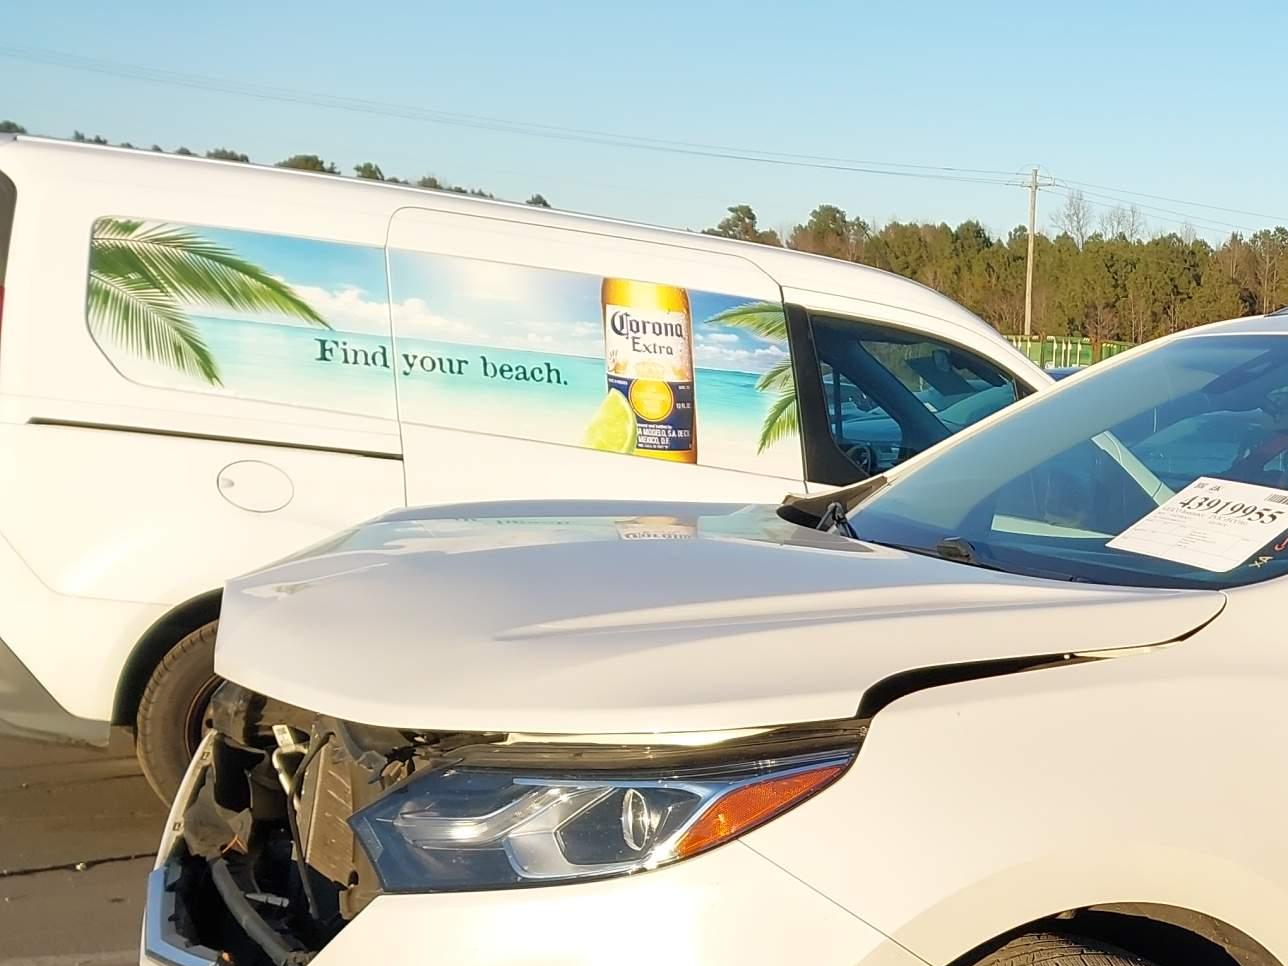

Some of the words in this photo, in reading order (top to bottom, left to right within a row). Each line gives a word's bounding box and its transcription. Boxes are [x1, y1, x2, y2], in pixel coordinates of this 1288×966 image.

[610, 311, 685, 340] Corona
[631, 336, 674, 355] Extra
[314, 338, 390, 369] Find
[402, 353, 469, 376] your
[480, 356, 569, 386] beach.
[1179, 495, 1286, 525] 43919955
